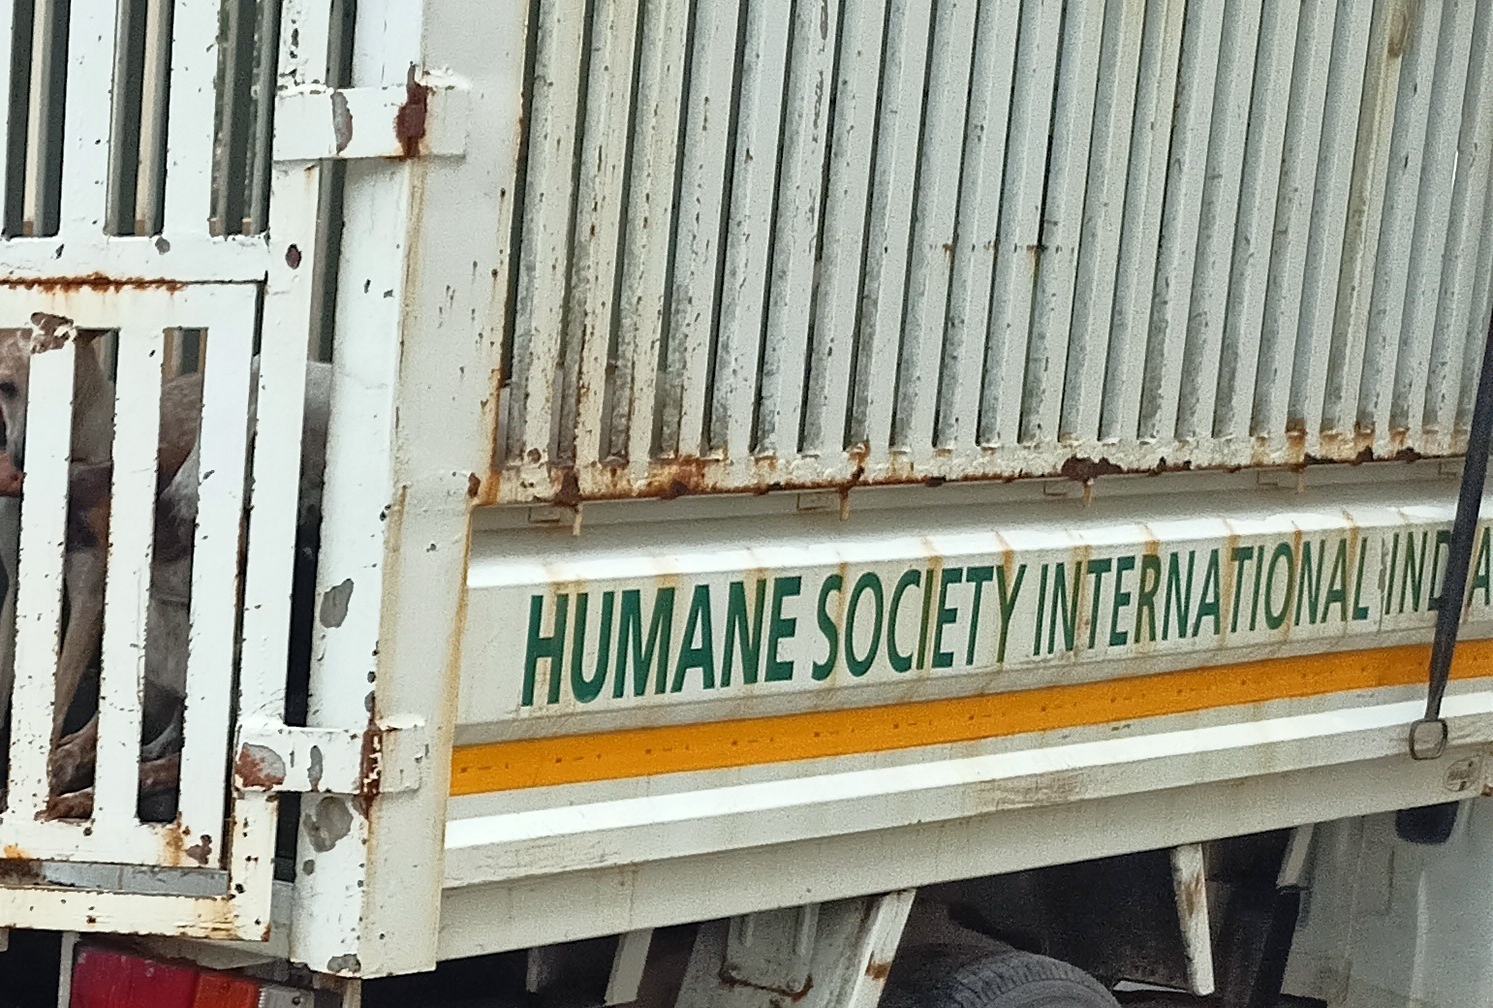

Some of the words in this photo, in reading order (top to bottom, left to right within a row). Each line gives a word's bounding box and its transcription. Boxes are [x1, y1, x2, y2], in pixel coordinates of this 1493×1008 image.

[521, 575, 802, 708] HUMANE
[812, 561, 1026, 682] SOCIETY
[1032, 536, 1369, 657] INTERNATIONAL
[1384, 525, 1493, 616] INDA
